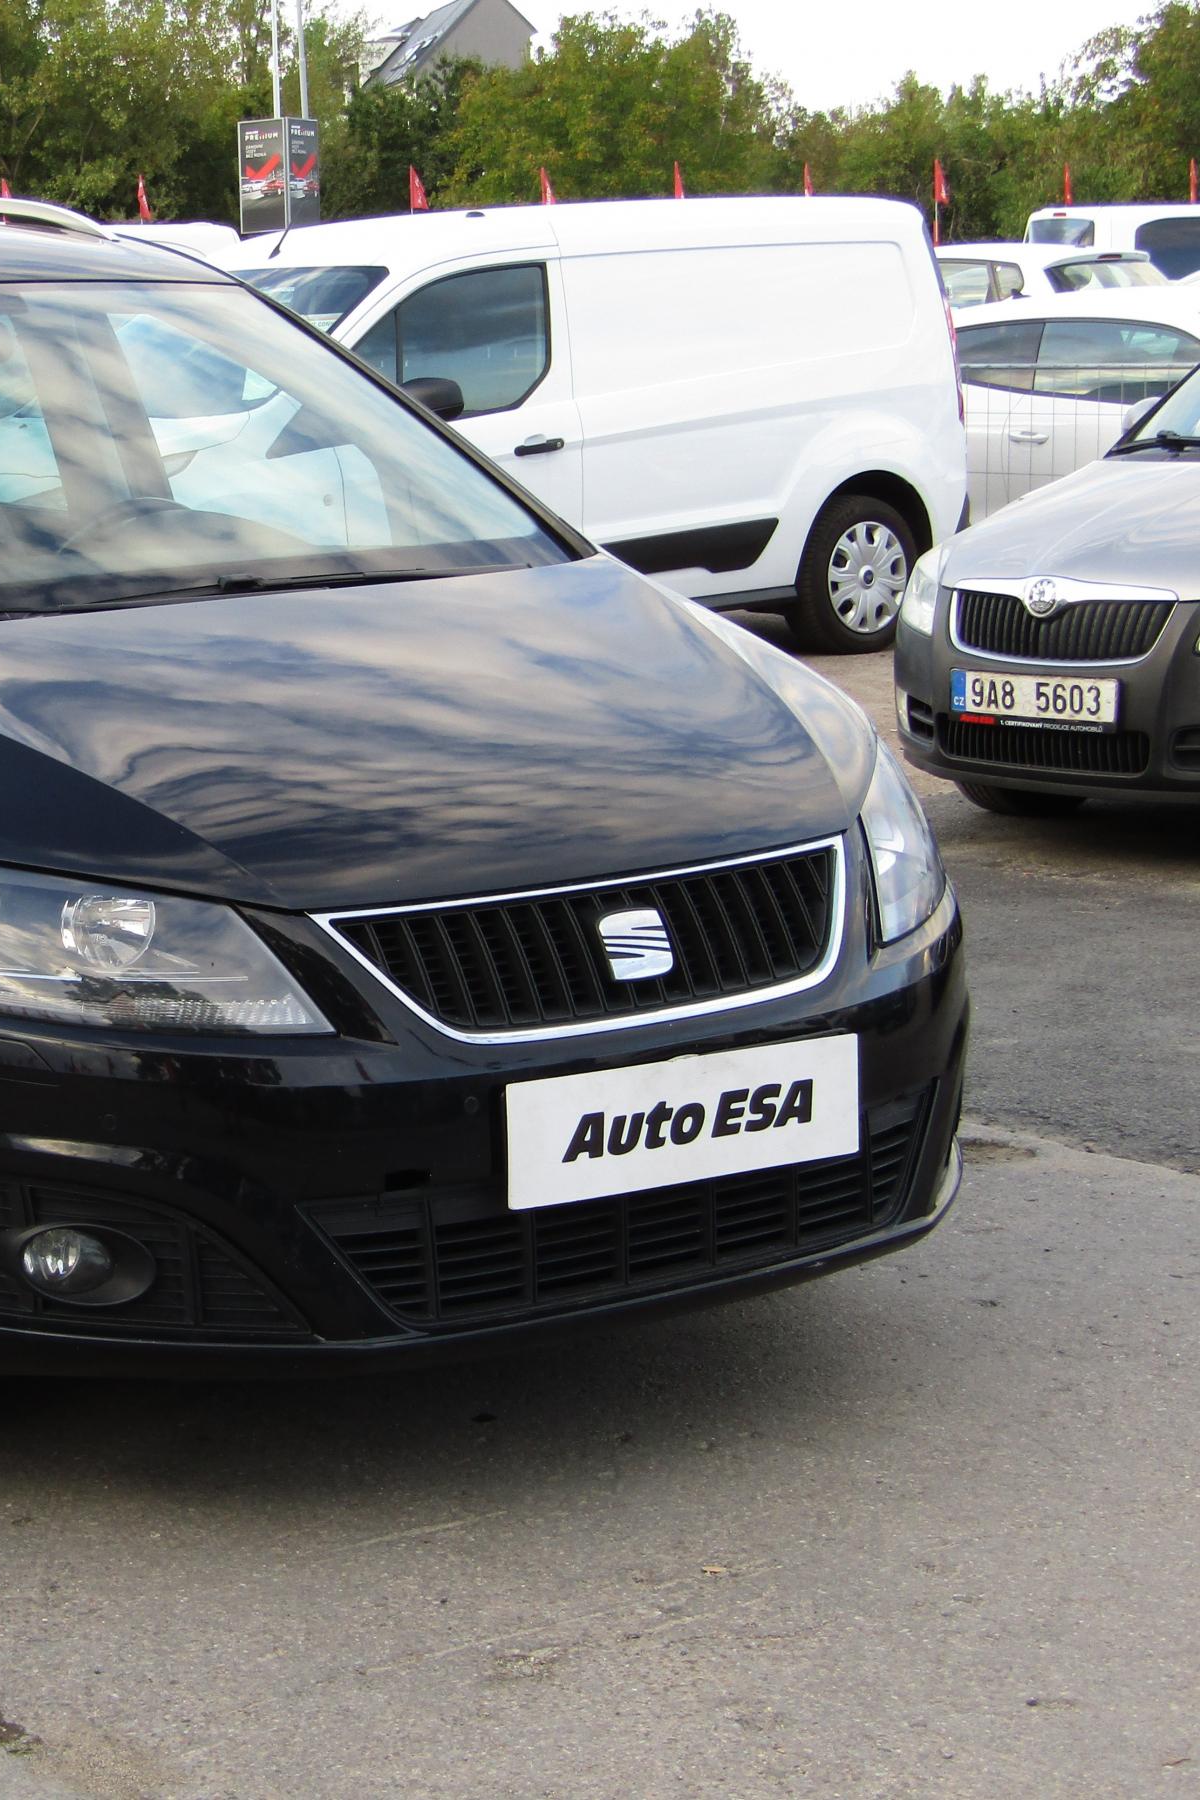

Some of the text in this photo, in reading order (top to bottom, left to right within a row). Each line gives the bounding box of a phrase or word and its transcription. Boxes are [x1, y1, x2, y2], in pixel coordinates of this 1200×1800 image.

[953, 695, 965, 706] CZ
[971, 677, 1101, 716] 9A8 5603
[561, 1078, 813, 1163] Auto ESA
